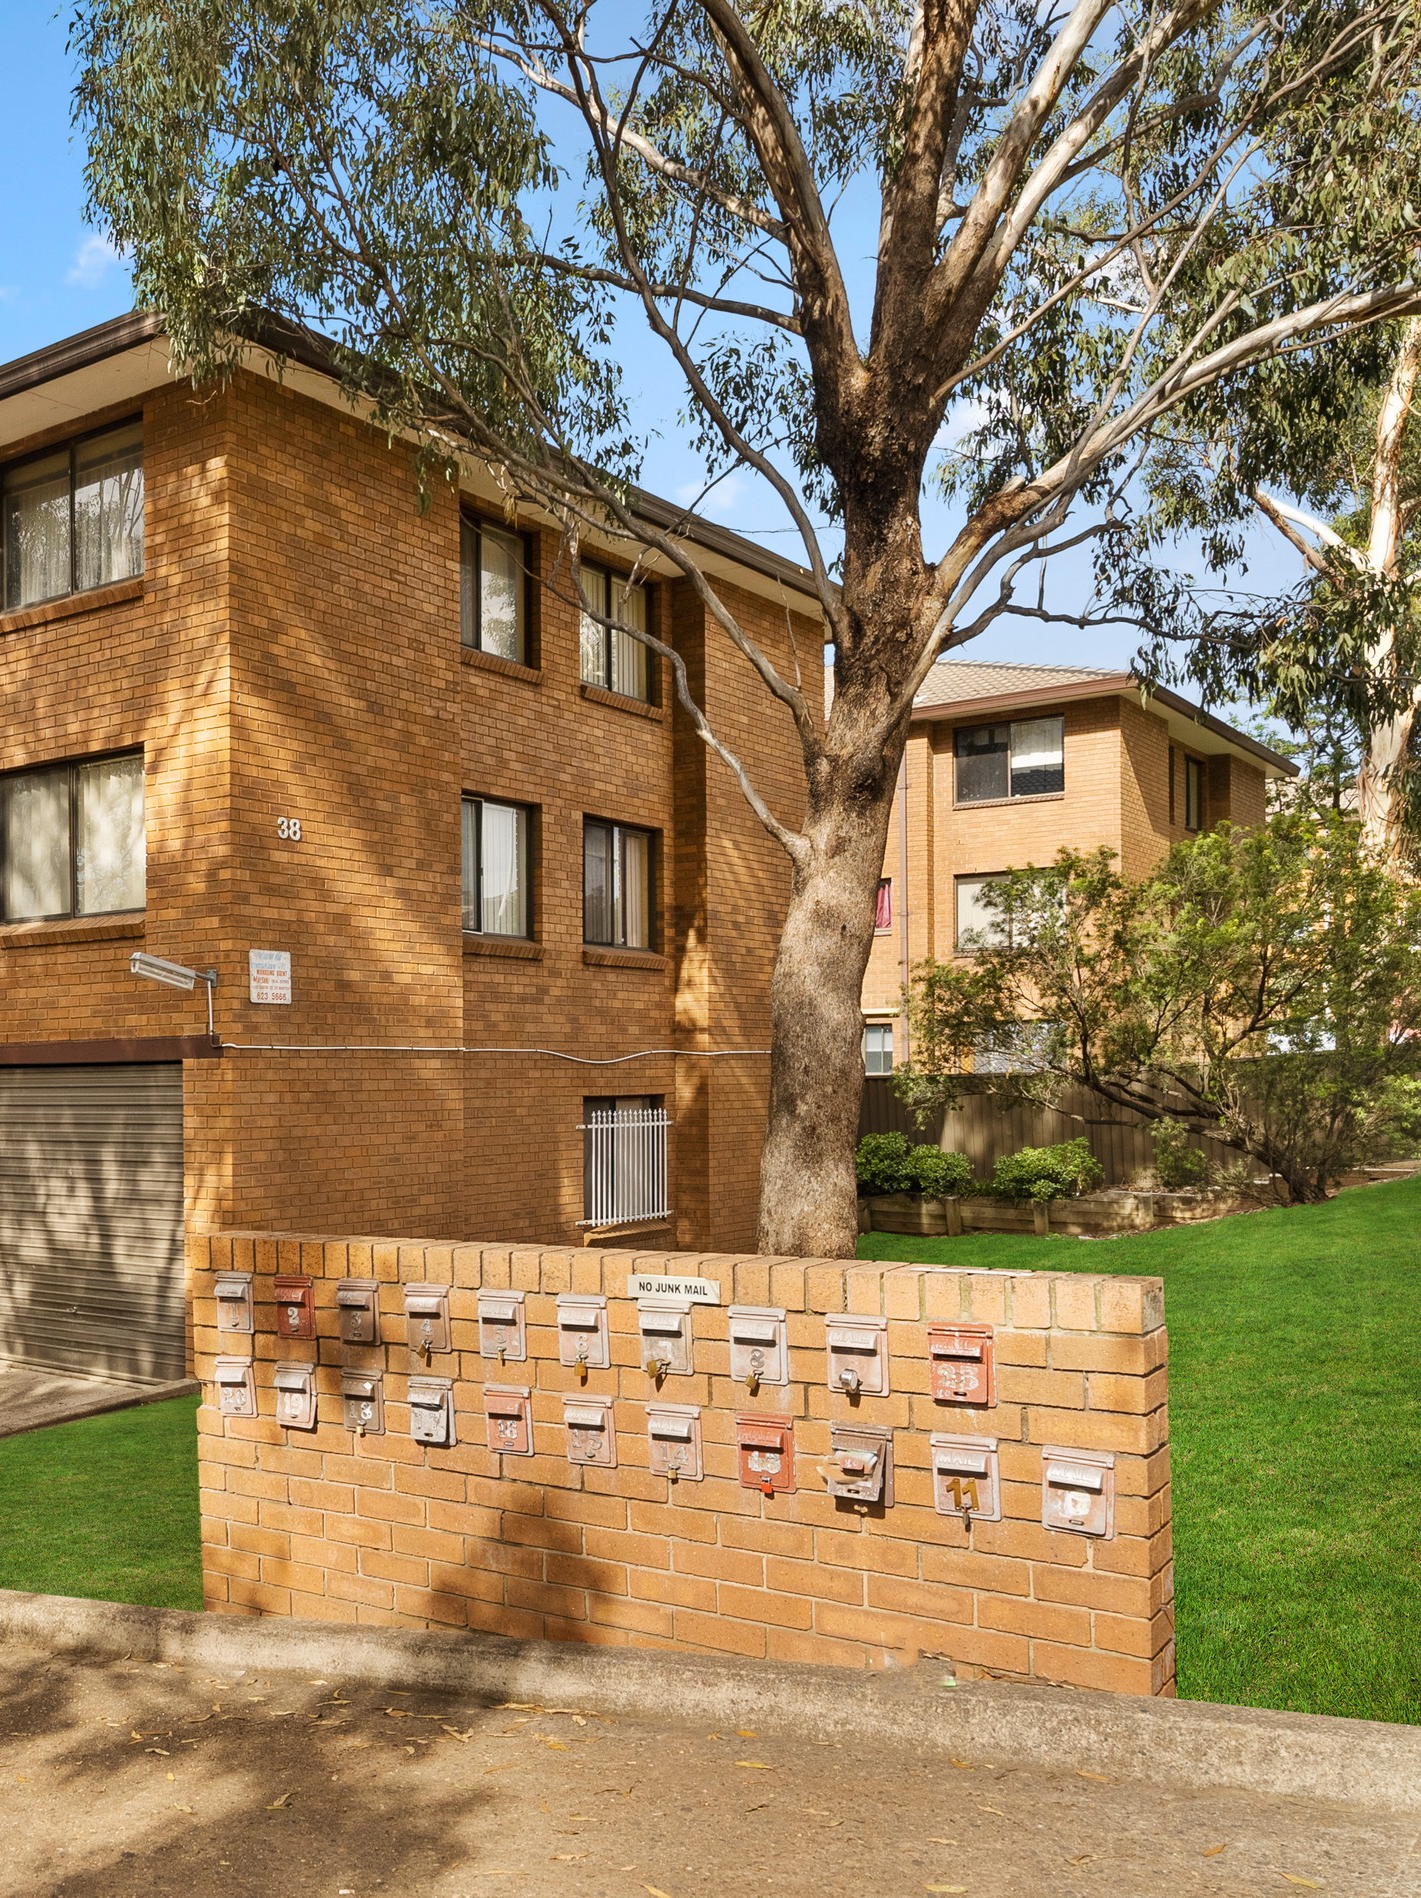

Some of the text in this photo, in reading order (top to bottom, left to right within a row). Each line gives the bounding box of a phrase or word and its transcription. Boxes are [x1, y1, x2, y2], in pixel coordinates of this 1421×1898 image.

[278, 816, 301, 841] 38
[639, 1281, 708, 1296] NO JUNK MAIL
[287, 1307, 299, 1325] 2
[349, 1311, 362, 1329] 3
[420, 1318, 434, 1337] 4
[494, 1325, 508, 1344] 5
[576, 1334, 589, 1354] 6
[831, 1330, 871, 1345] MAIL
[658, 1341, 676, 1362] 7
[750, 1348, 766, 1368] 8
[283, 1392, 303, 1415] 19
[348, 1401, 373, 1420] 18
[659, 1443, 689, 1466] 14
[938, 1453, 980, 1467] MAIL
[1050, 1464, 1095, 1482] MAIL
[945, 1477, 980, 1511] 11
